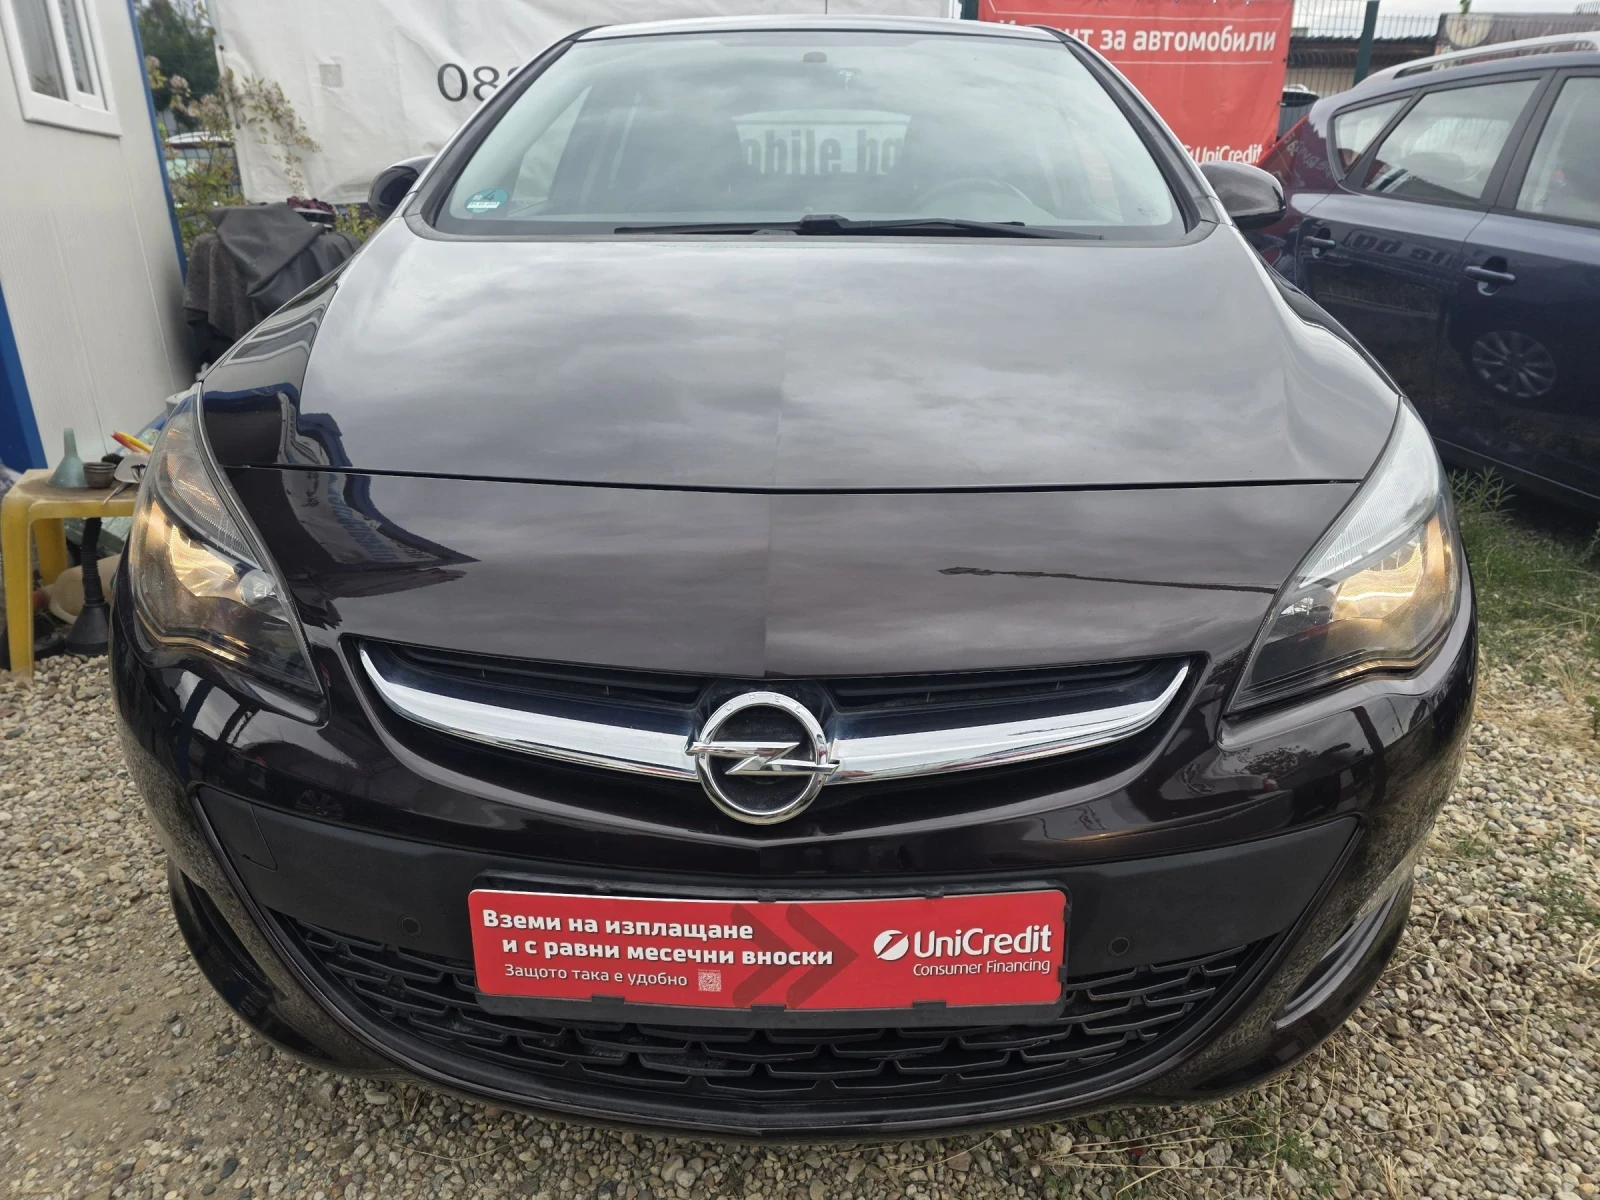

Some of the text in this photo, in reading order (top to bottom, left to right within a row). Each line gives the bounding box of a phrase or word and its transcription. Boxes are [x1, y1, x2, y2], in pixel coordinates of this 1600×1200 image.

[1099, 28, 1125, 51] за
[1133, 25, 1277, 53] автомобили
[437, 63, 519, 102] 08
[1195, 143, 1263, 164] UniCredit
[482, 909, 754, 942] Вземи на изплащане
[502, 939, 833, 966] и с равни месечни вноски
[913, 924, 1052, 959] UniCredit
[504, 964, 688, 986] Защото така е удобно
[913, 957, 1051, 976] Consumer Financing
